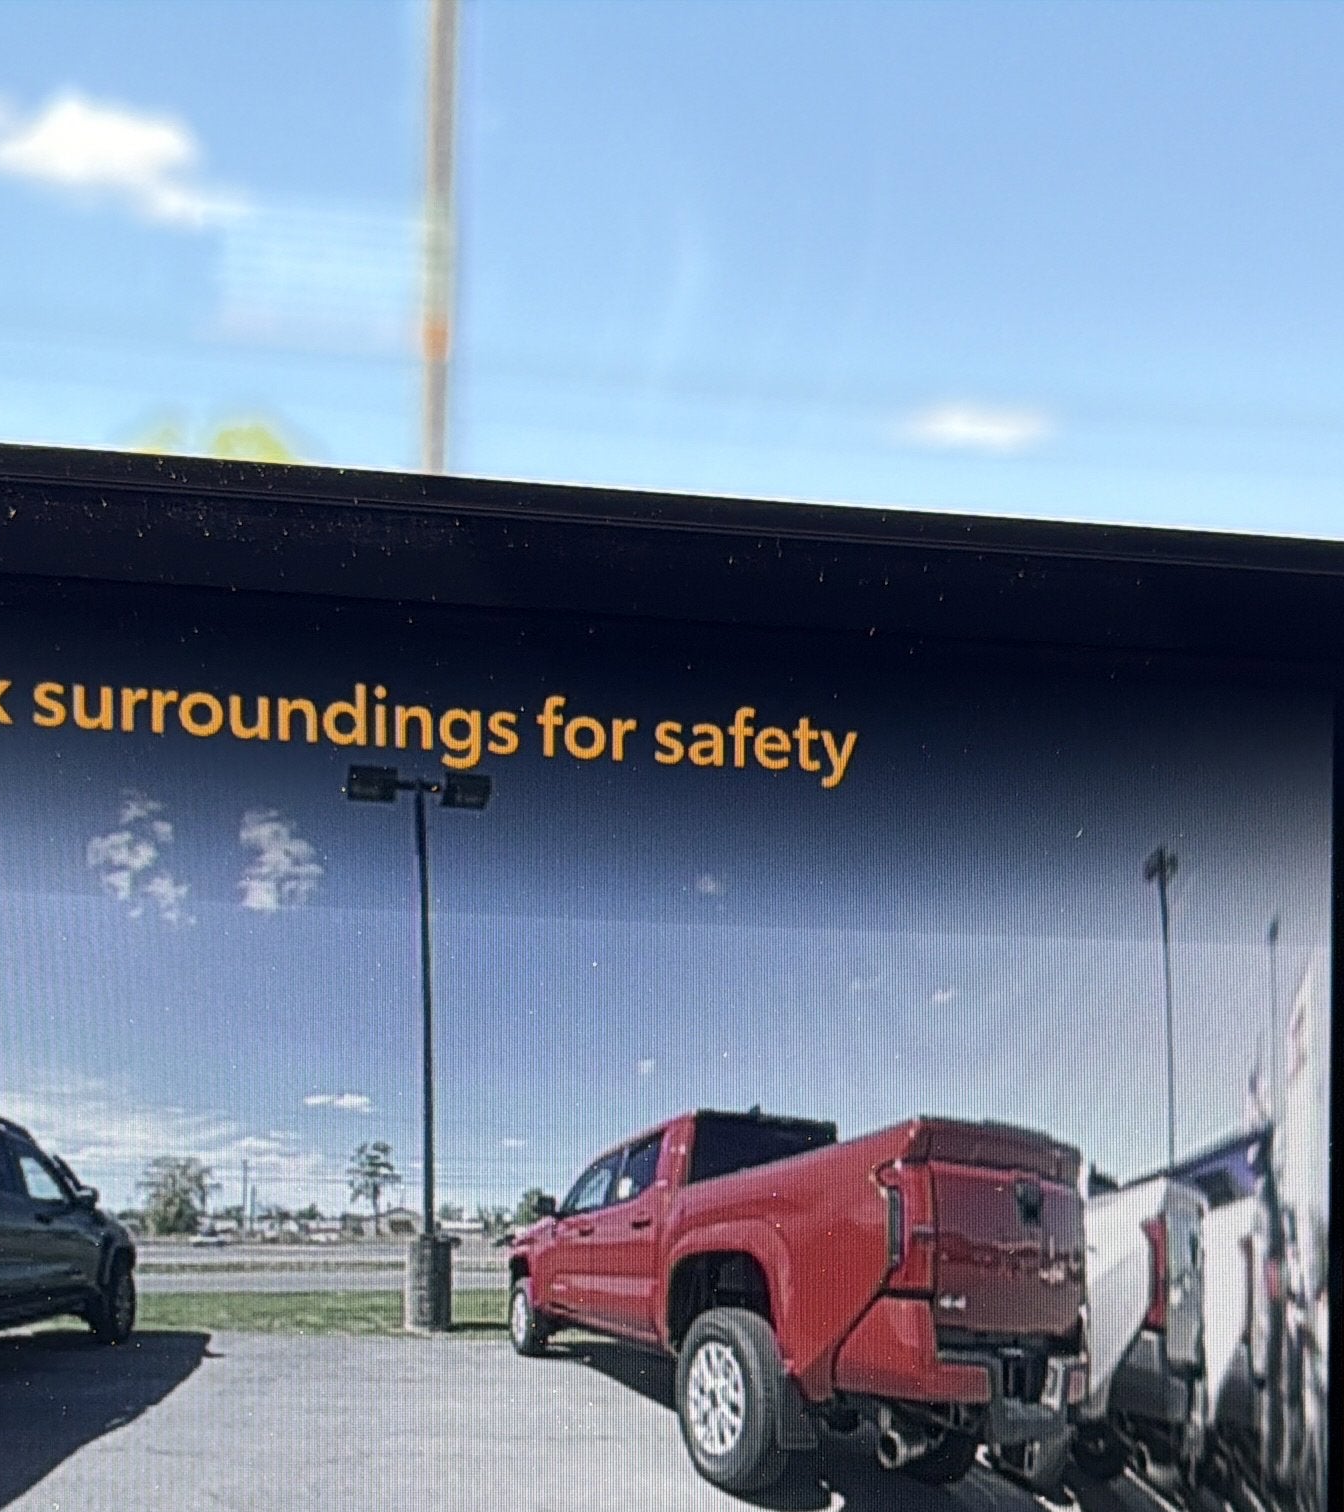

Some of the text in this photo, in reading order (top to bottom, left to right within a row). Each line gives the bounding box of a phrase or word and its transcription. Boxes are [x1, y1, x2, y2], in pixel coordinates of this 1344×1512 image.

[33, 680, 519, 770] surroundings
[537, 696, 637, 761] for
[654, 706, 857, 788] safety
